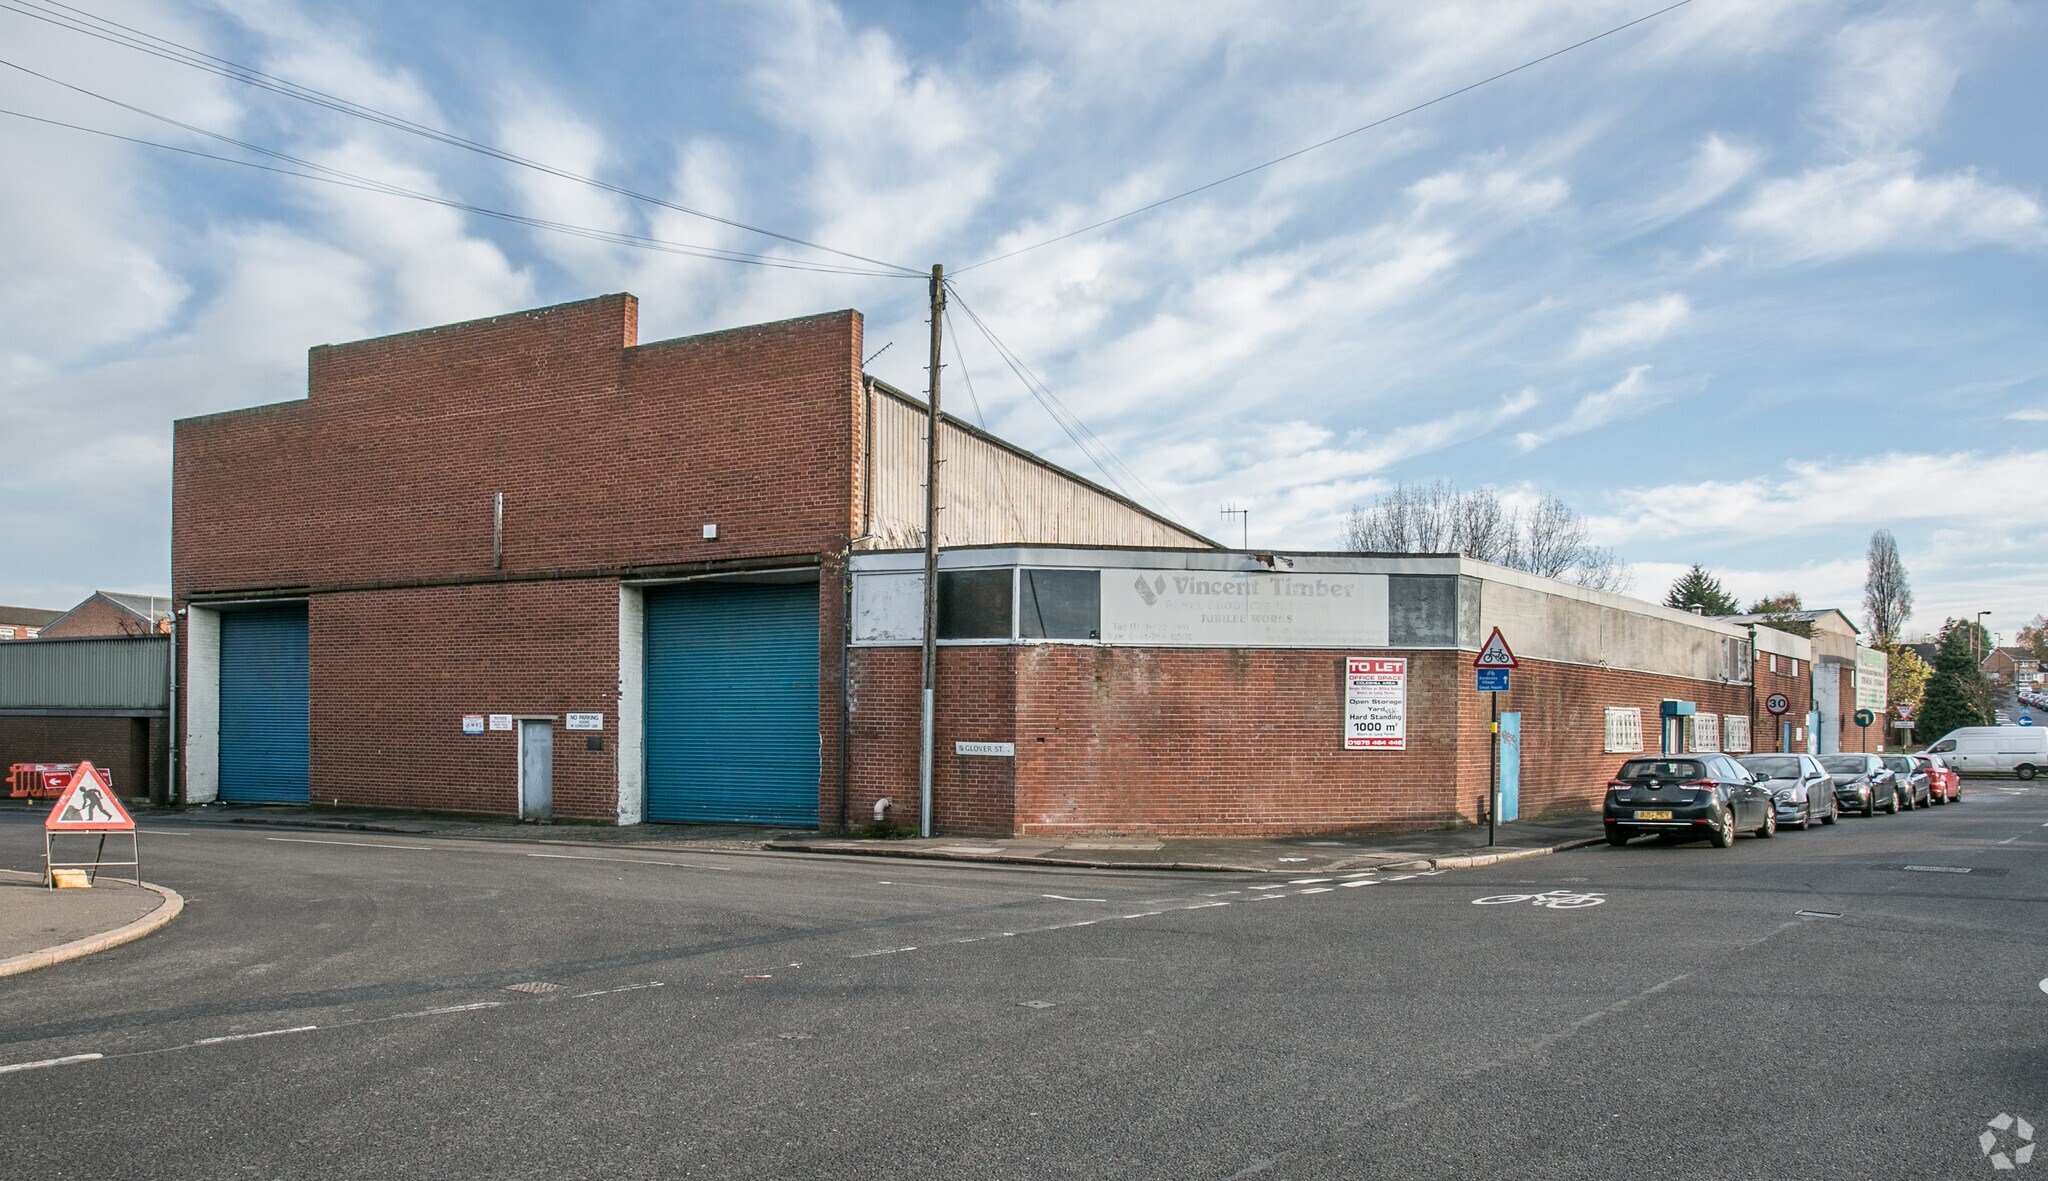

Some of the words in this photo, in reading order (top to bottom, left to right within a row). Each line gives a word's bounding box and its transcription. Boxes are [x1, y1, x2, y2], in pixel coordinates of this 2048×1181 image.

[1173, 575, 1259, 596] Vincent
[1270, 577, 1354, 598] Timber
[1201, 614, 1246, 624] JUBILEE
[1251, 614, 1293, 624] WORKS
[1350, 662, 1370, 672] TO
[1375, 662, 1402, 672] LET
[1769, 699, 1786, 708] 30
[1353, 722, 1382, 731] 1000
